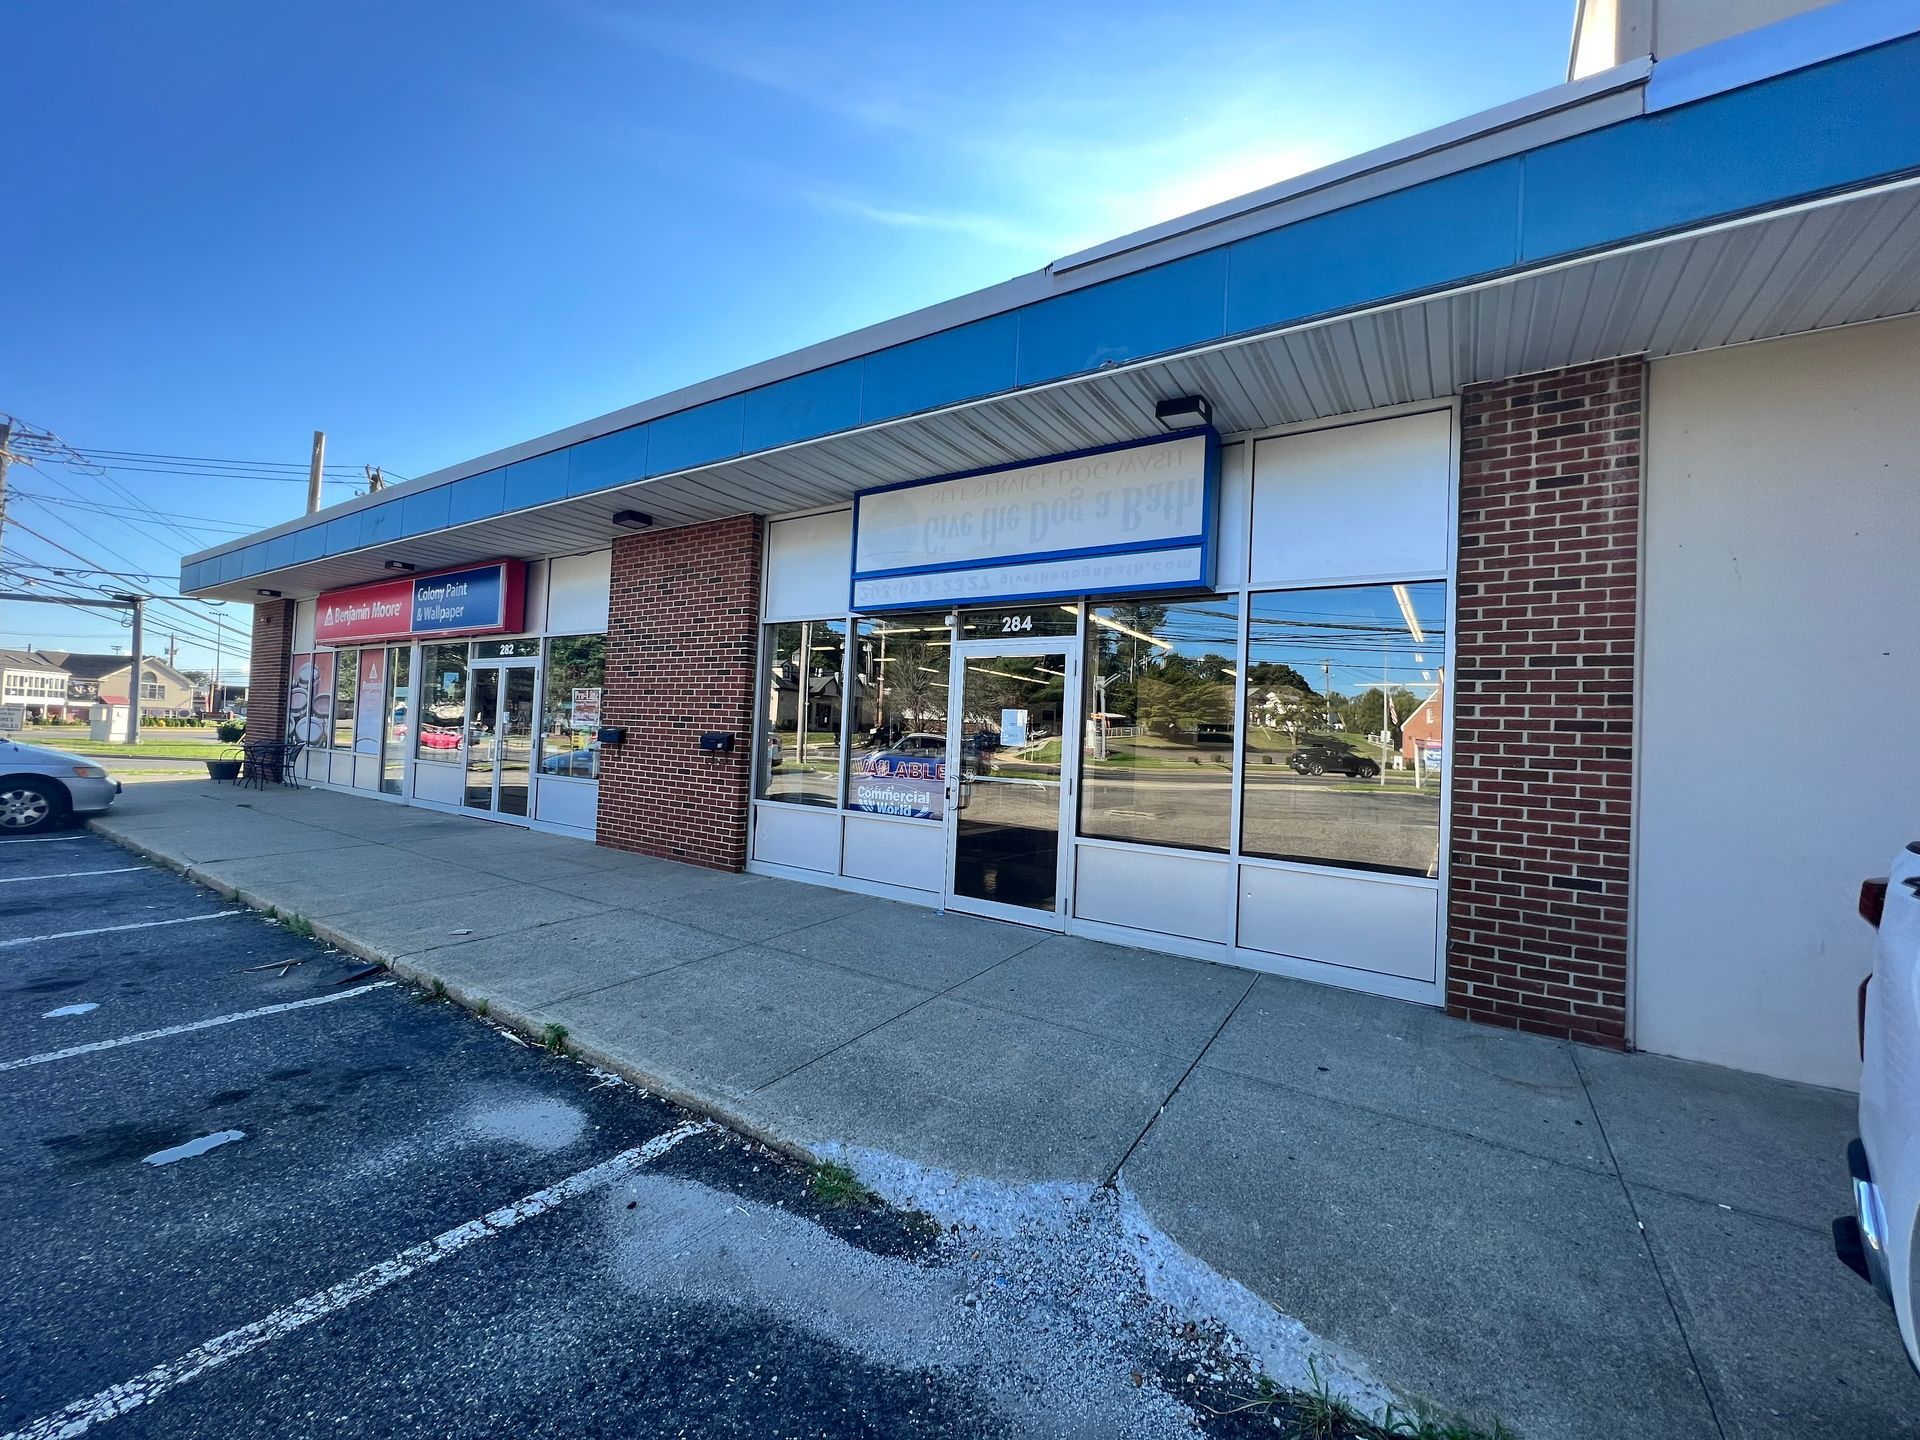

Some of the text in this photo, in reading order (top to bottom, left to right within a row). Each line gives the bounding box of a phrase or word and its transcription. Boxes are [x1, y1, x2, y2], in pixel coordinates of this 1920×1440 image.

[417, 581, 468, 602] Colony Paint
[334, 600, 401, 625] Benjamin Moore
[416, 605, 465, 623] & Wallpaper
[1001, 615, 1033, 633] 284
[499, 644, 515, 656] 282
[857, 785, 930, 804] Commercial
[876, 801, 912, 817] World
